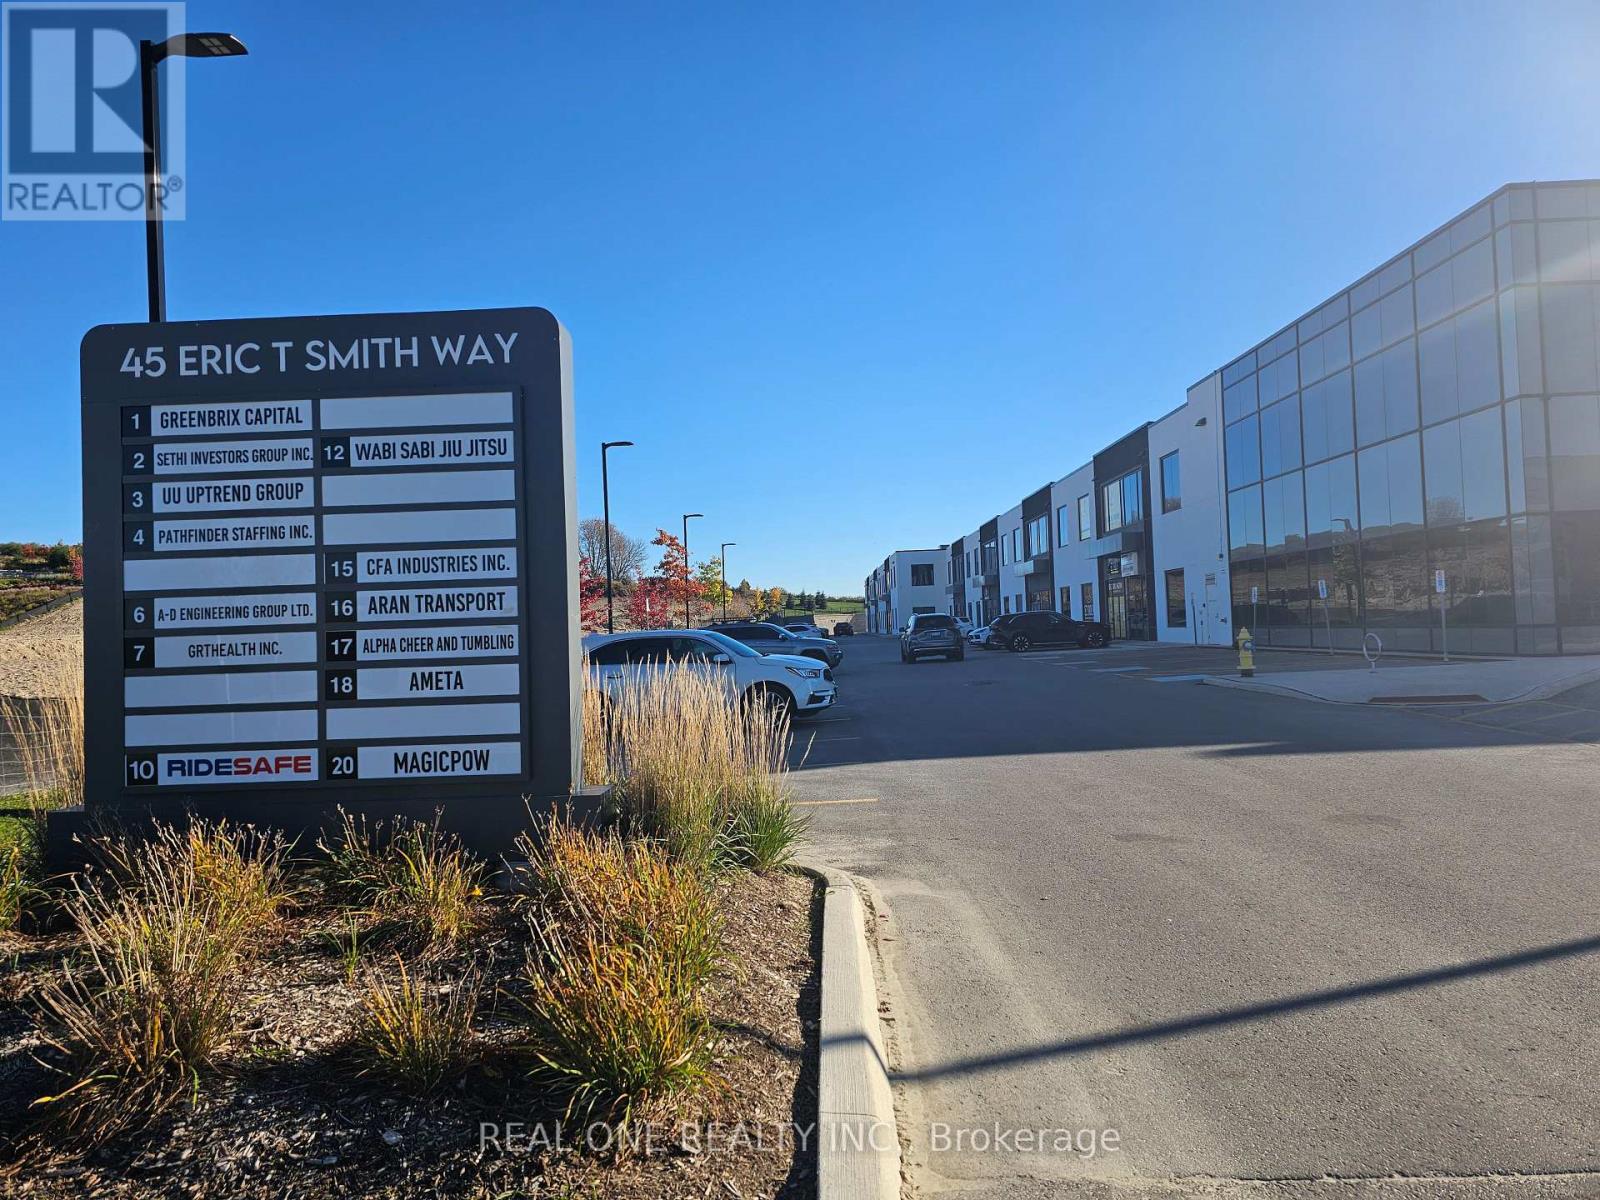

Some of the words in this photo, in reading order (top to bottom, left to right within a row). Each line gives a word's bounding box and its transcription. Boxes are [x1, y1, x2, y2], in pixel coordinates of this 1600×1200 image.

[120, 346, 167, 378] 45
[179, 342, 261, 376] ERIC
[271, 341, 294, 373] T
[305, 336, 419, 372] SMITH
[431, 332, 519, 366] WAY
[131, 413, 140, 430] 1
[160, 408, 241, 429] GREENBRIX
[244, 406, 304, 426] CAPITAL
[133, 452, 145, 470] 2
[157, 451, 187, 466] SETHI
[190, 449, 249, 466] INVESTORS
[252, 448, 288, 464] GROUP
[291, 447, 314, 461] INC.
[323, 445, 345, 461] 12
[355, 442, 396, 461] WABI
[400, 440, 435, 459] SABI
[439, 440, 462, 458] JIU
[466, 438, 508, 457] JITSU
[132, 491, 144, 508] 3
[162, 487, 181, 505] UU
[186, 484, 251, 504] UPTREND
[256, 482, 305, 501] GROUP
[132, 529, 145, 545] 4
[158, 527, 229, 544] PATHFINDER
[232, 525, 286, 542] STAFFING
[289, 524, 313, 539] INC.
[331, 560, 354, 577] 15
[366, 558, 393, 575] CFA
[397, 555, 478, 575] INDUSTRIES
[482, 554, 511, 571] INC.
[133, 606, 146, 623] 6
[158, 607, 177, 622] A-D
[180, 605, 250, 621] ENGINEERING
[252, 604, 288, 619] GROUP
[291, 603, 313, 617] LTD.
[331, 600, 354, 616] 16
[368, 596, 410, 615] ARAN
[415, 591, 506, 613] TRANSPORT
[133, 645, 146, 662] 7
[188, 642, 256, 658] GRTHEALTH
[259, 641, 283, 656] INC.
[331, 638, 353, 655] 17
[363, 636, 397, 654] ALPHA
[400, 636, 433, 652] CHEER
[437, 635, 458, 651] AND
[461, 634, 514, 650] TUMBLING
[330, 676, 353, 693] 18
[409, 671, 464, 691] AMETA
[129, 760, 154, 780] 10
[167, 755, 312, 777] RIDESAFE
[331, 756, 354, 775] 20
[393, 749, 491, 774] MAGICPOW
